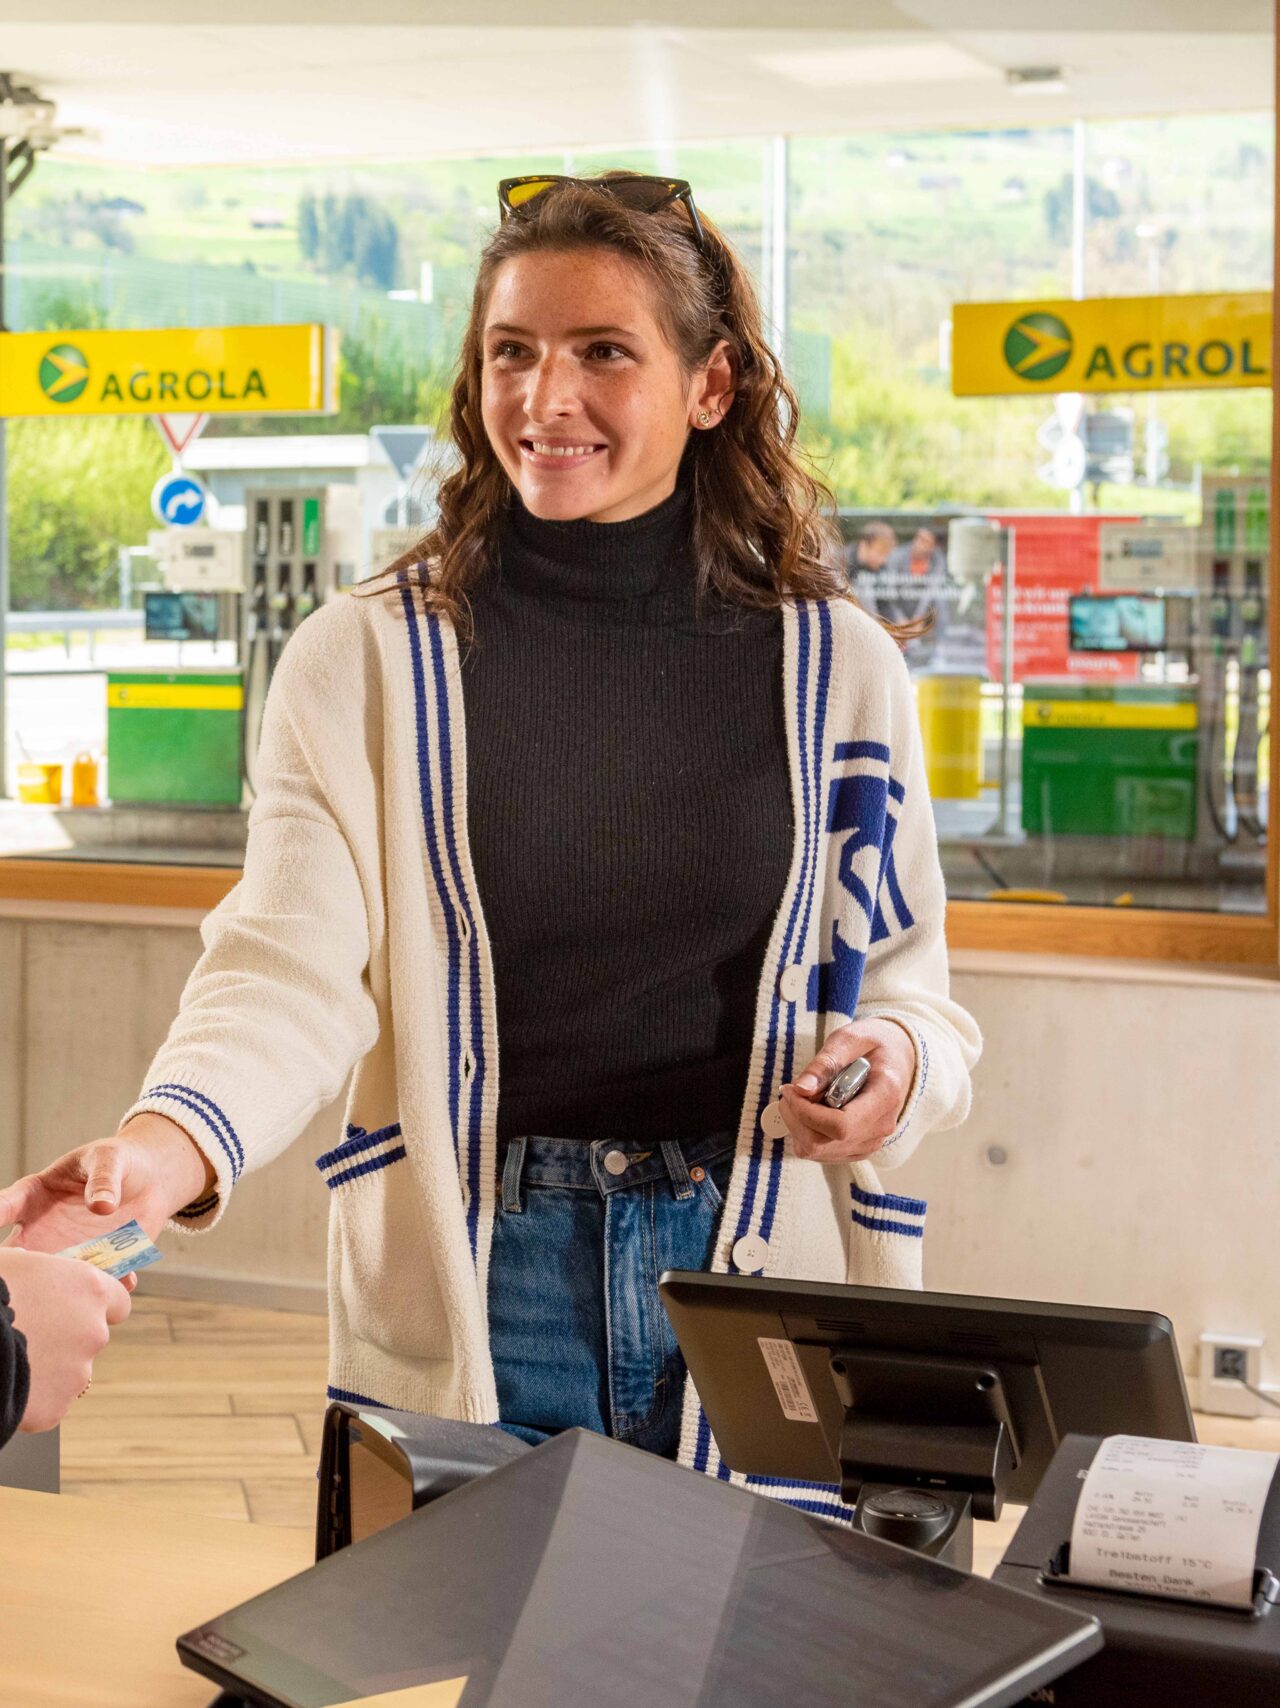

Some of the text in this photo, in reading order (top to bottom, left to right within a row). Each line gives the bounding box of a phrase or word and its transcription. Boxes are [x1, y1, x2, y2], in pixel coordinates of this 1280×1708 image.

[1083, 338, 1269, 381] AGROL
[99, 367, 268, 402] AGROLA
[1096, 1547, 1173, 1565] Treibstoff
[1108, 1568, 1195, 1587] Besten Dank
